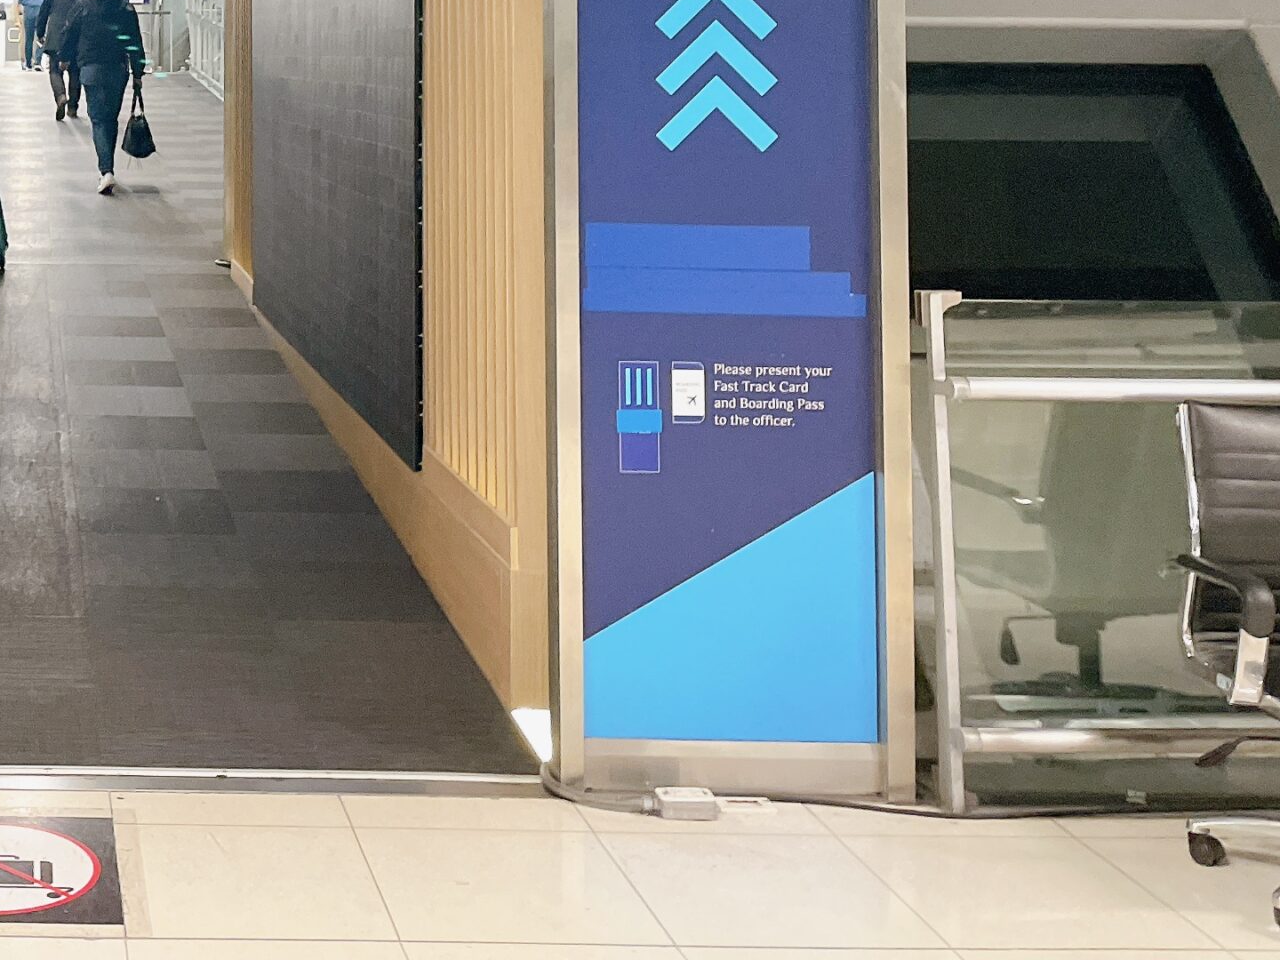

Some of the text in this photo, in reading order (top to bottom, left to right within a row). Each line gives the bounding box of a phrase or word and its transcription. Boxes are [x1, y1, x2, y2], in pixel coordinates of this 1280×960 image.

[713, 364, 833, 379] Please present your
[713, 380, 739, 393] Fast
[741, 381, 777, 393] Track
[778, 381, 809, 394] Card
[713, 398, 825, 413] and Boarding Pass
[714, 415, 796, 427] to the officer.
